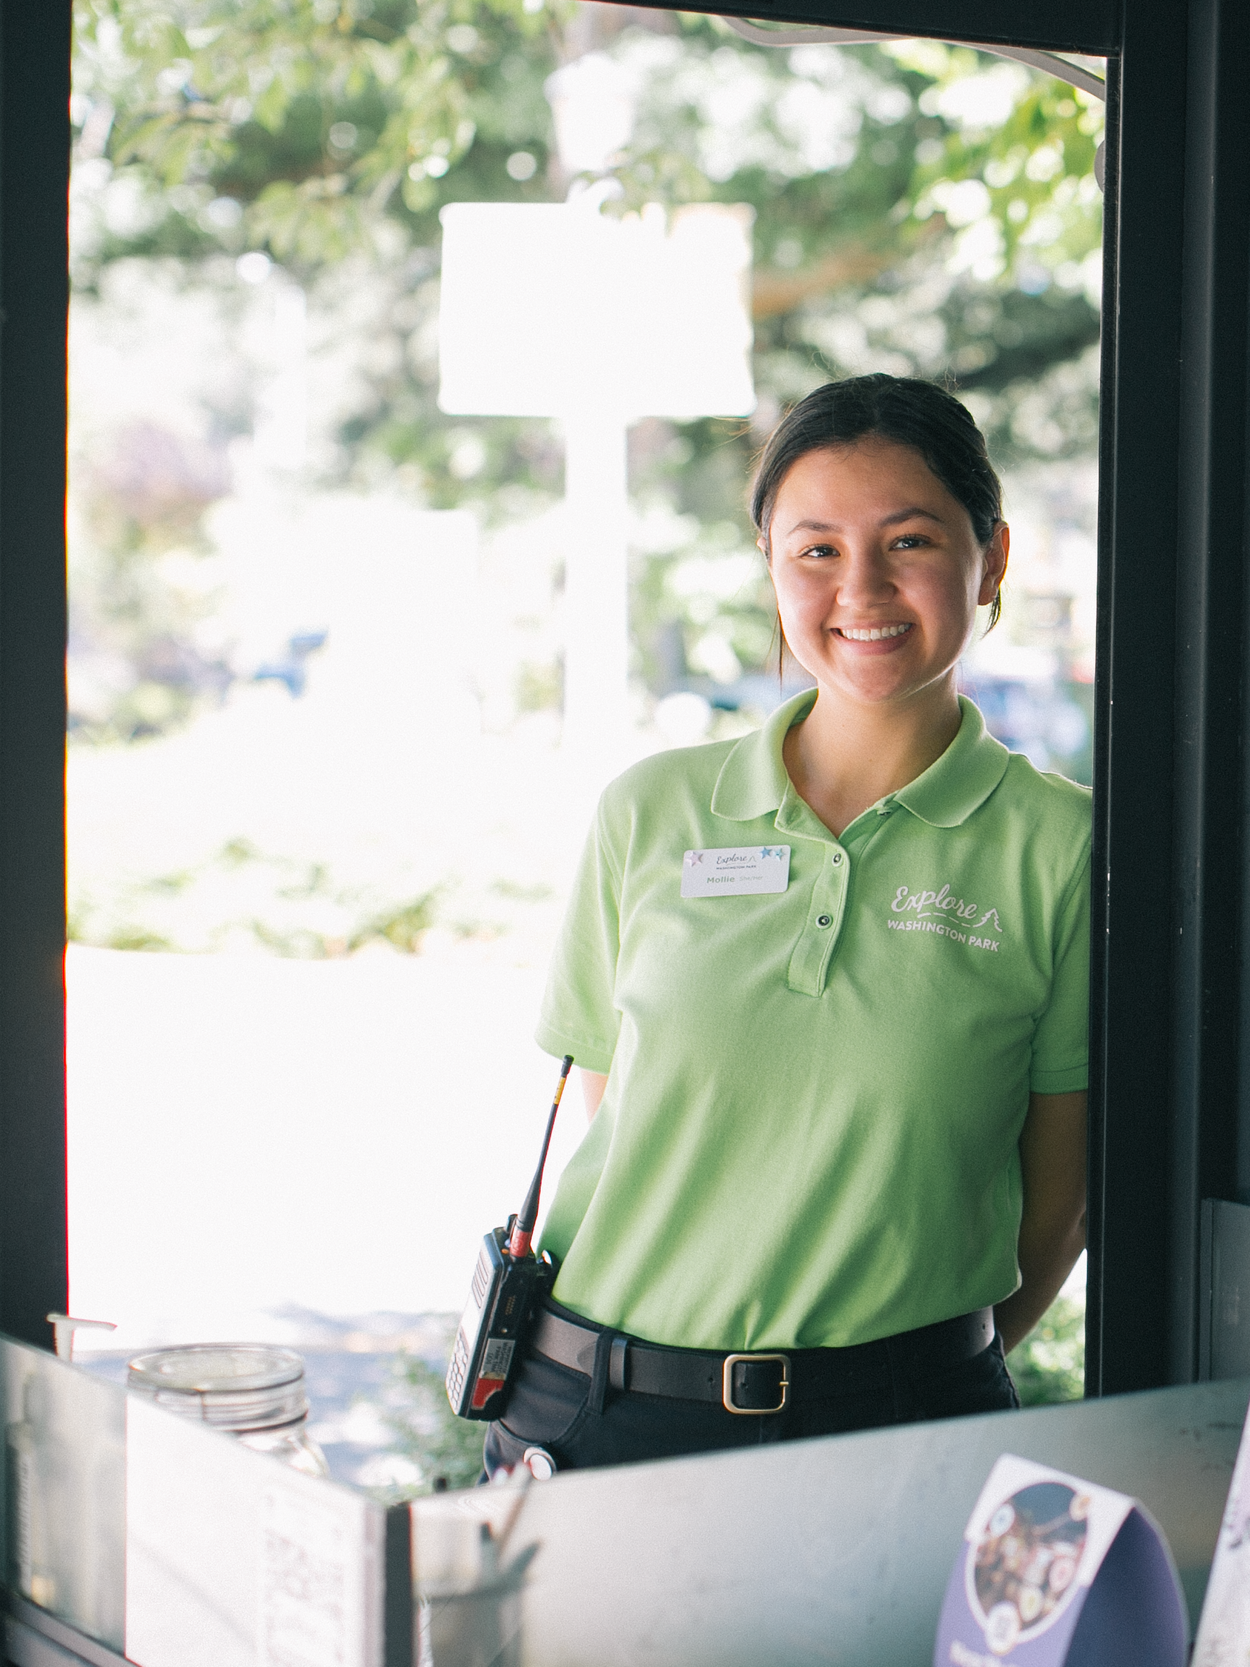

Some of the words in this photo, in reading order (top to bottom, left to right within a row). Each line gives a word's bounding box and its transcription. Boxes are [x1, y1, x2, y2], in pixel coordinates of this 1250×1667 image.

[716, 853, 748, 865] Explore
[706, 875, 736, 884] Mollie
[890, 883, 978, 919] Explore
[887, 919, 967, 944] WASHINGTON
[968, 935, 1000, 952] PARK
